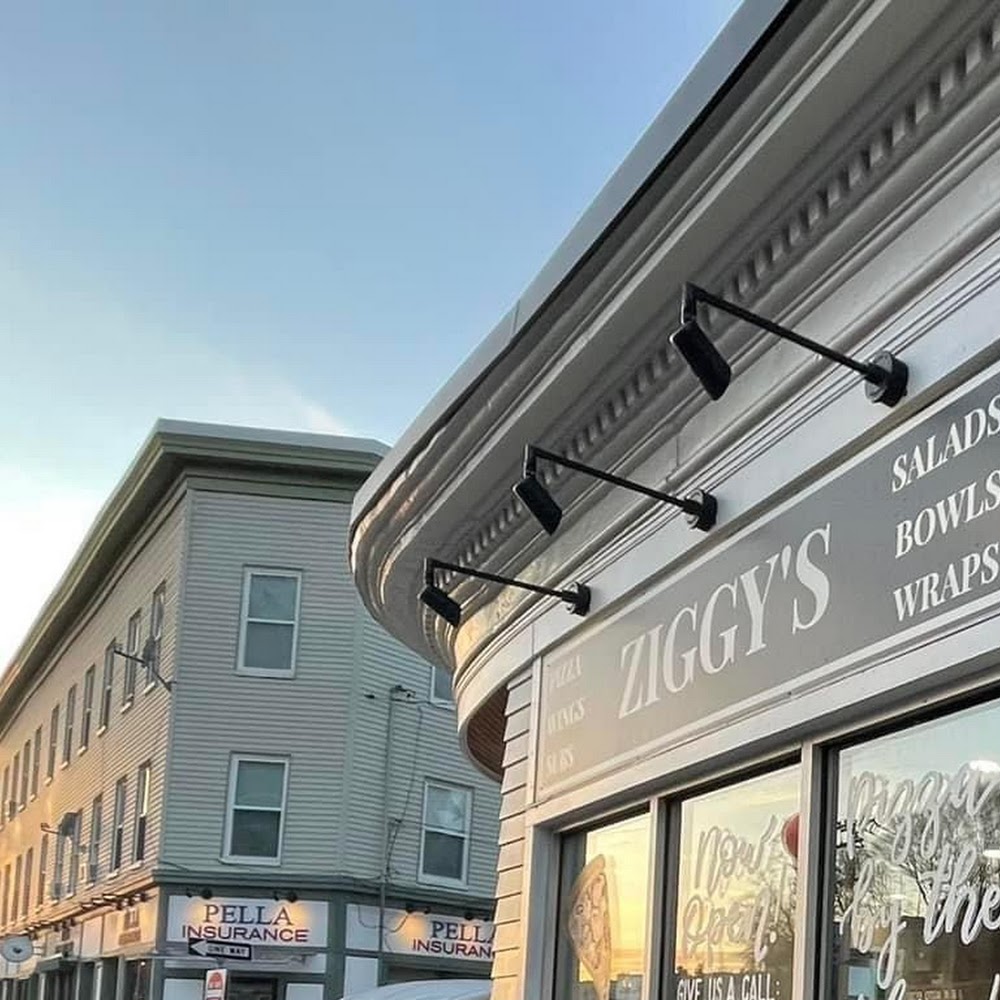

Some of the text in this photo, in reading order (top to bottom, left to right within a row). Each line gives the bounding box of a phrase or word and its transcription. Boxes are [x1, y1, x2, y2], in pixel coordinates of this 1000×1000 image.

[892, 543, 1000, 622] WRAPS
[617, 523, 832, 720] ZIGGY'S
[182, 925, 310, 943] INSURANCE
[202, 904, 294, 926] PELLA
[429, 920, 494, 944] PELL
[840, 859, 907, 990] by
